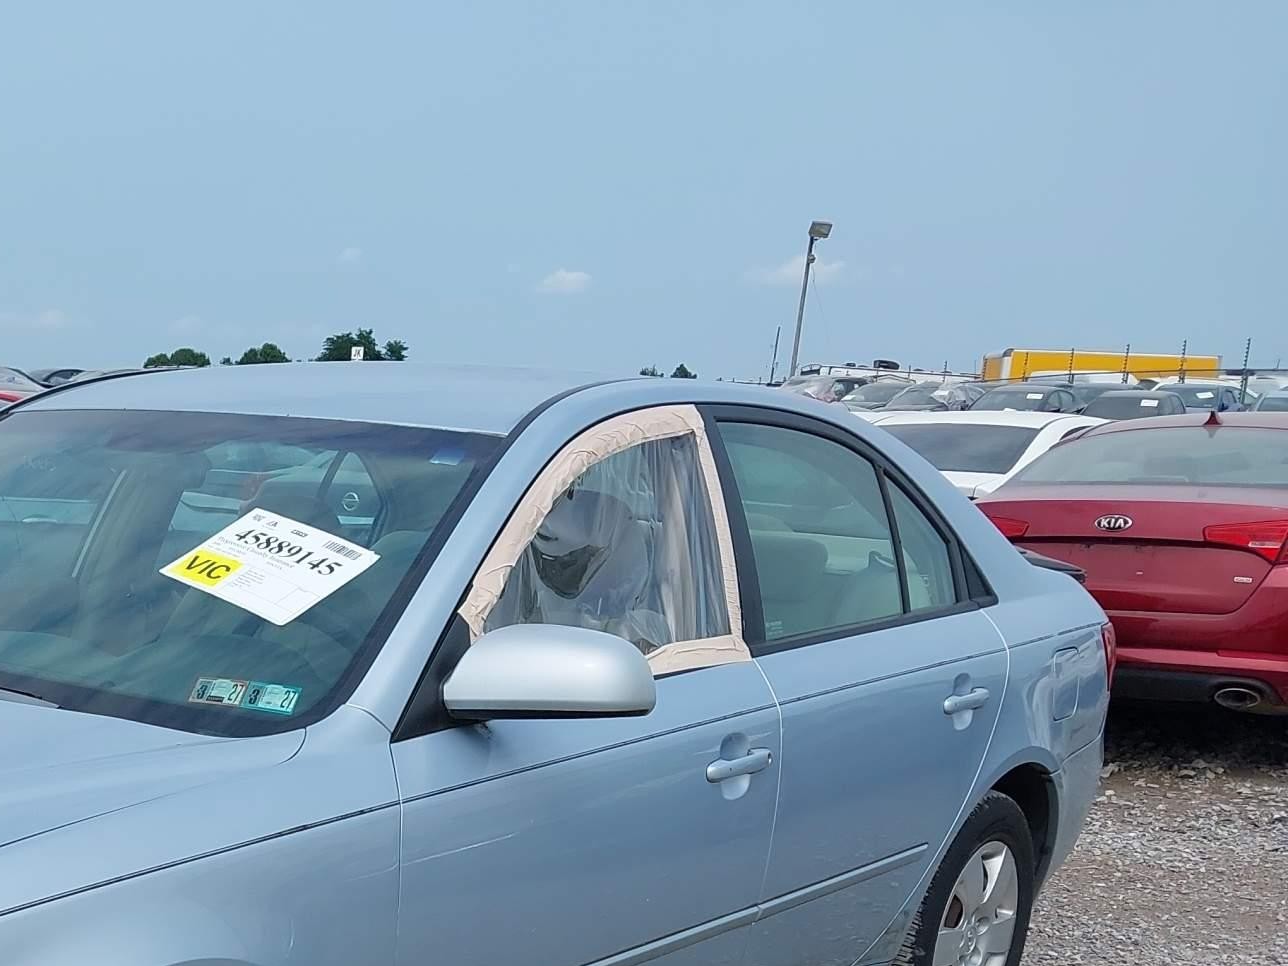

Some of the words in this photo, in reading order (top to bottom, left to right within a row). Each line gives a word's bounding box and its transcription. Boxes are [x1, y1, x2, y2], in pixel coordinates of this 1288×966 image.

[1100, 518, 1124, 529] KIA
[234, 529, 343, 577] 45889145
[185, 555, 231, 580] VIC
[197, 684, 208, 700] 3
[228, 683, 244, 701] 27
[249, 688, 260, 705] 3
[280, 690, 296, 709] 27
